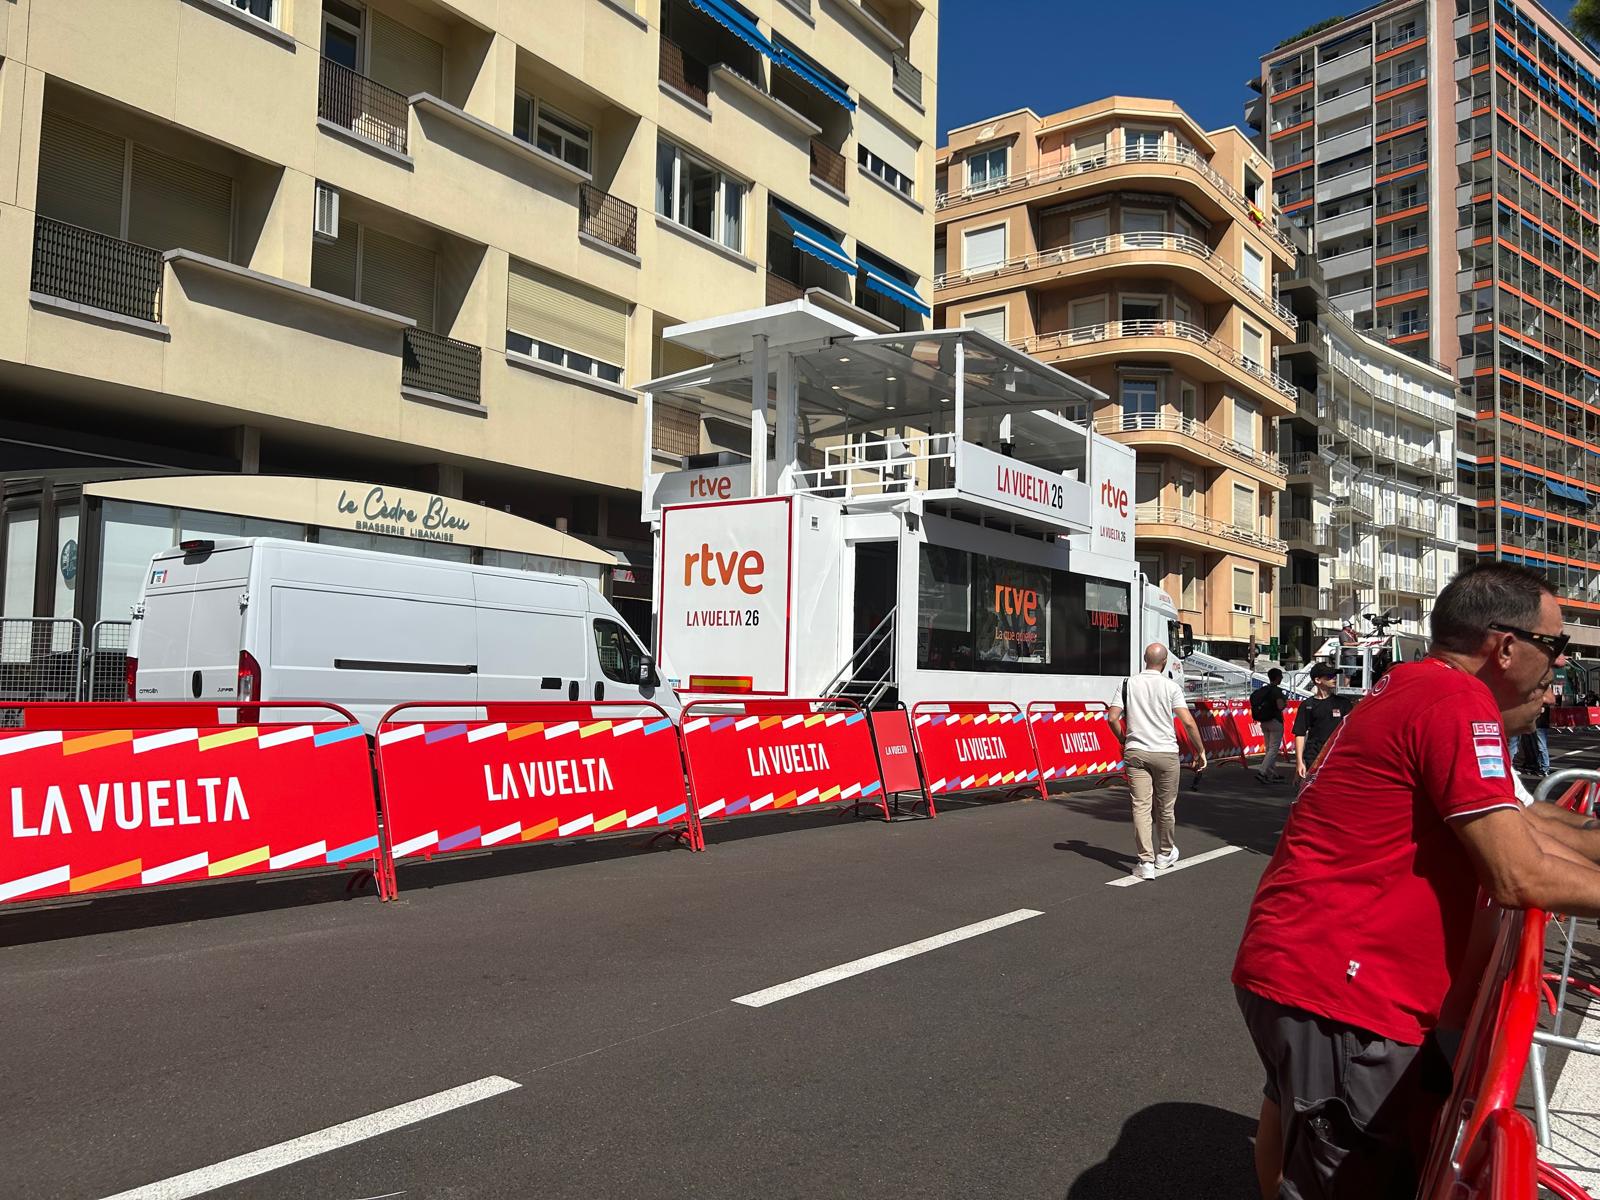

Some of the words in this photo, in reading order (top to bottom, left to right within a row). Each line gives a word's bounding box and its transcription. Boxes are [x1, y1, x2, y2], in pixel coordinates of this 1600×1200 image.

[690, 475, 731, 499] rtve
[998, 465, 1010, 494] LA
[1012, 470, 1050, 505] VUELTA
[1051, 484, 1063, 510] 26
[1101, 479, 1128, 518] rtve
[422, 496, 470, 530] Bleu
[355, 520, 405, 536] BRASSERIE
[410, 528, 454, 542] LIBANAISE
[1105, 527, 1121, 541] VUELTA
[1120, 531, 1126, 543] 26
[684, 543, 765, 595] rtve
[687, 611, 699, 626] LA
[701, 610, 742, 626] VUELTA
[745, 609, 759, 626] 26
[994, 584, 1037, 625] rtve
[1099, 611, 1118, 628] VUELTA
[955, 738, 972, 762] LA
[968, 736, 1007, 761] VUELTA
[1060, 733, 1073, 754] LA
[1070, 731, 1101, 753] VUELTA
[747, 747, 771, 777] LA
[769, 743, 830, 774] VUELTA
[484, 763, 520, 801] LA
[519, 757, 614, 798] VUELTA
[11, 785, 72, 838] LA
[79, 776, 250, 832] VUELTA
